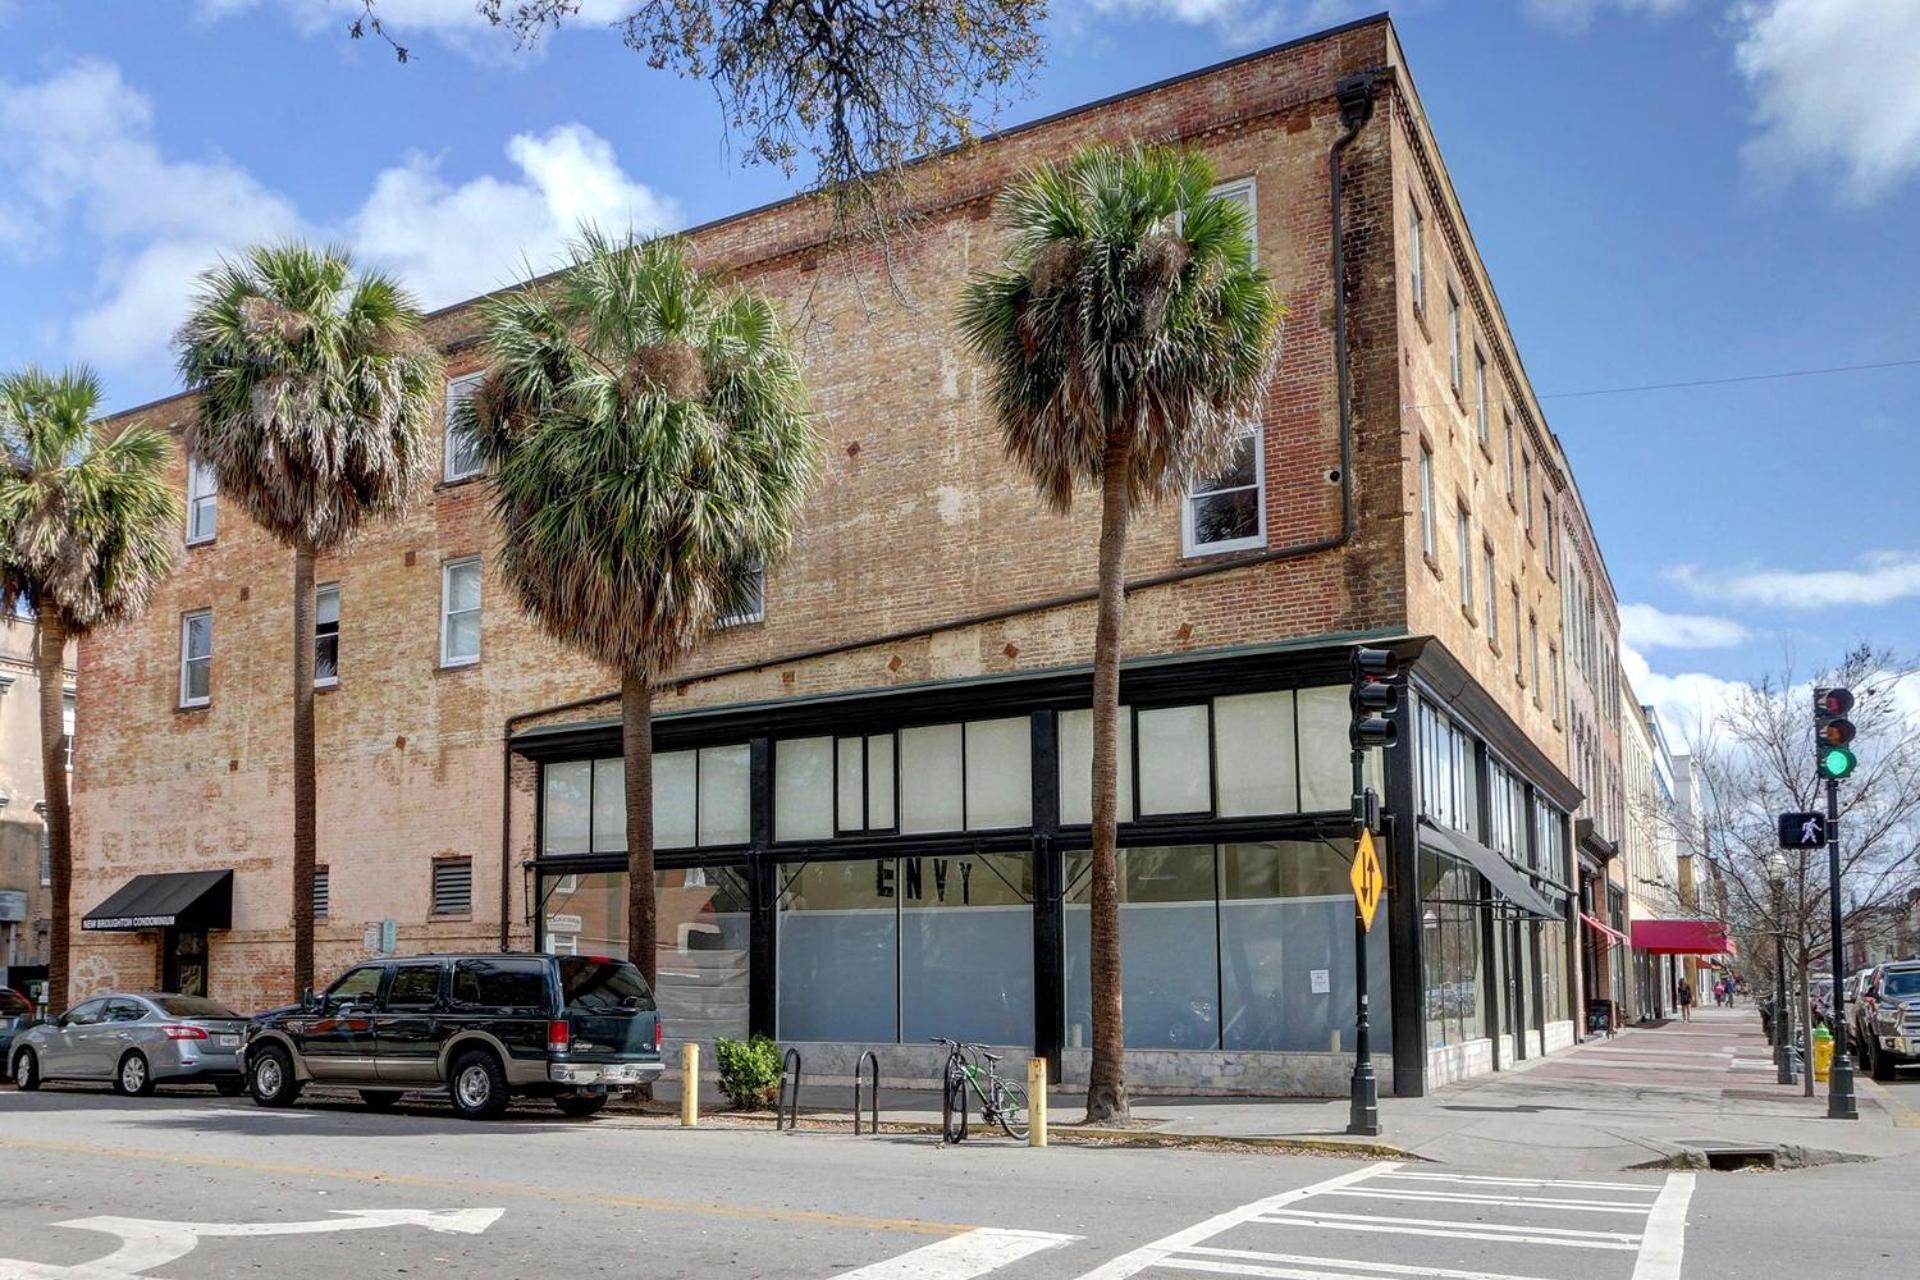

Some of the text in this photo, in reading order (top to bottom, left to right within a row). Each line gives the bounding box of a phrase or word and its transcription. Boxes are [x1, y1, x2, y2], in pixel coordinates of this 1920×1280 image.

[877, 857, 972, 904] ENVY
[83, 919, 96, 929] NEW
[97, 918, 132, 929] BROUGHTON
